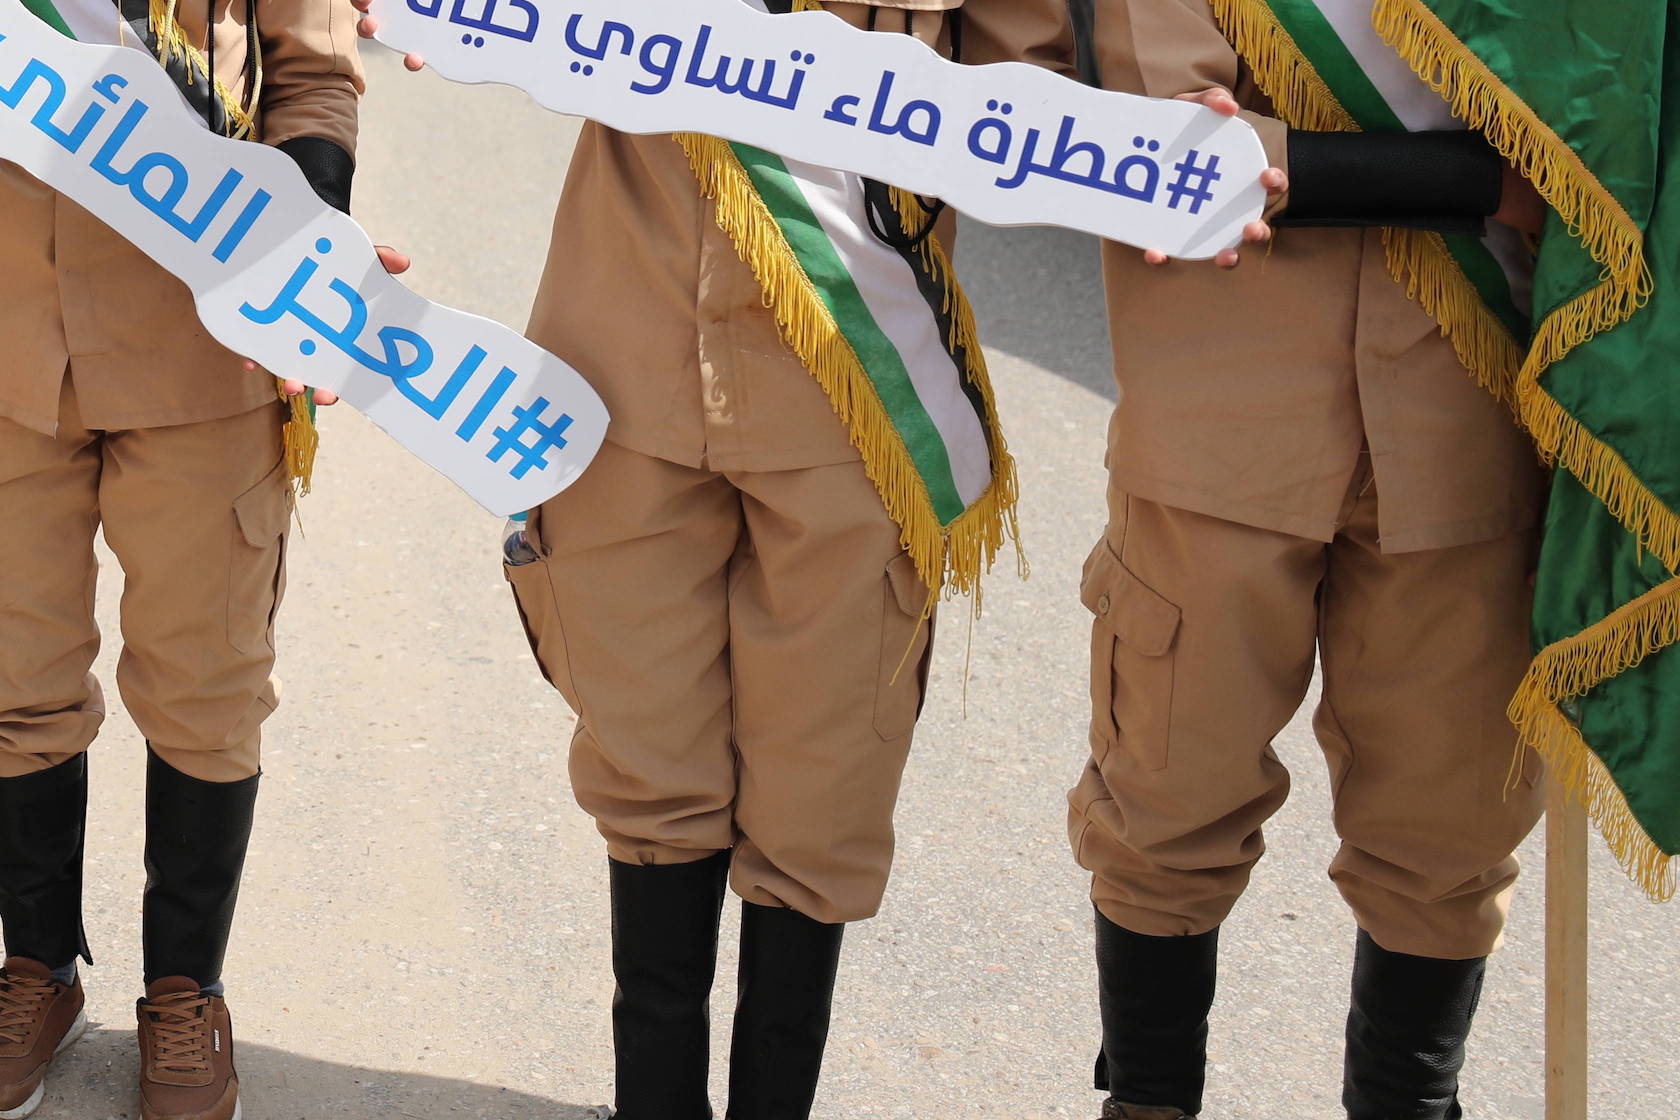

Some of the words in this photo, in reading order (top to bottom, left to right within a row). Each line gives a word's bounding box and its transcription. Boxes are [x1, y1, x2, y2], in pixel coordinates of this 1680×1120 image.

[565, 14, 815, 110] تساوي
[824, 71, 941, 146] ماء
[967, 99, 1220, 213] #قطرة
[239, 237, 574, 480] #العجز
